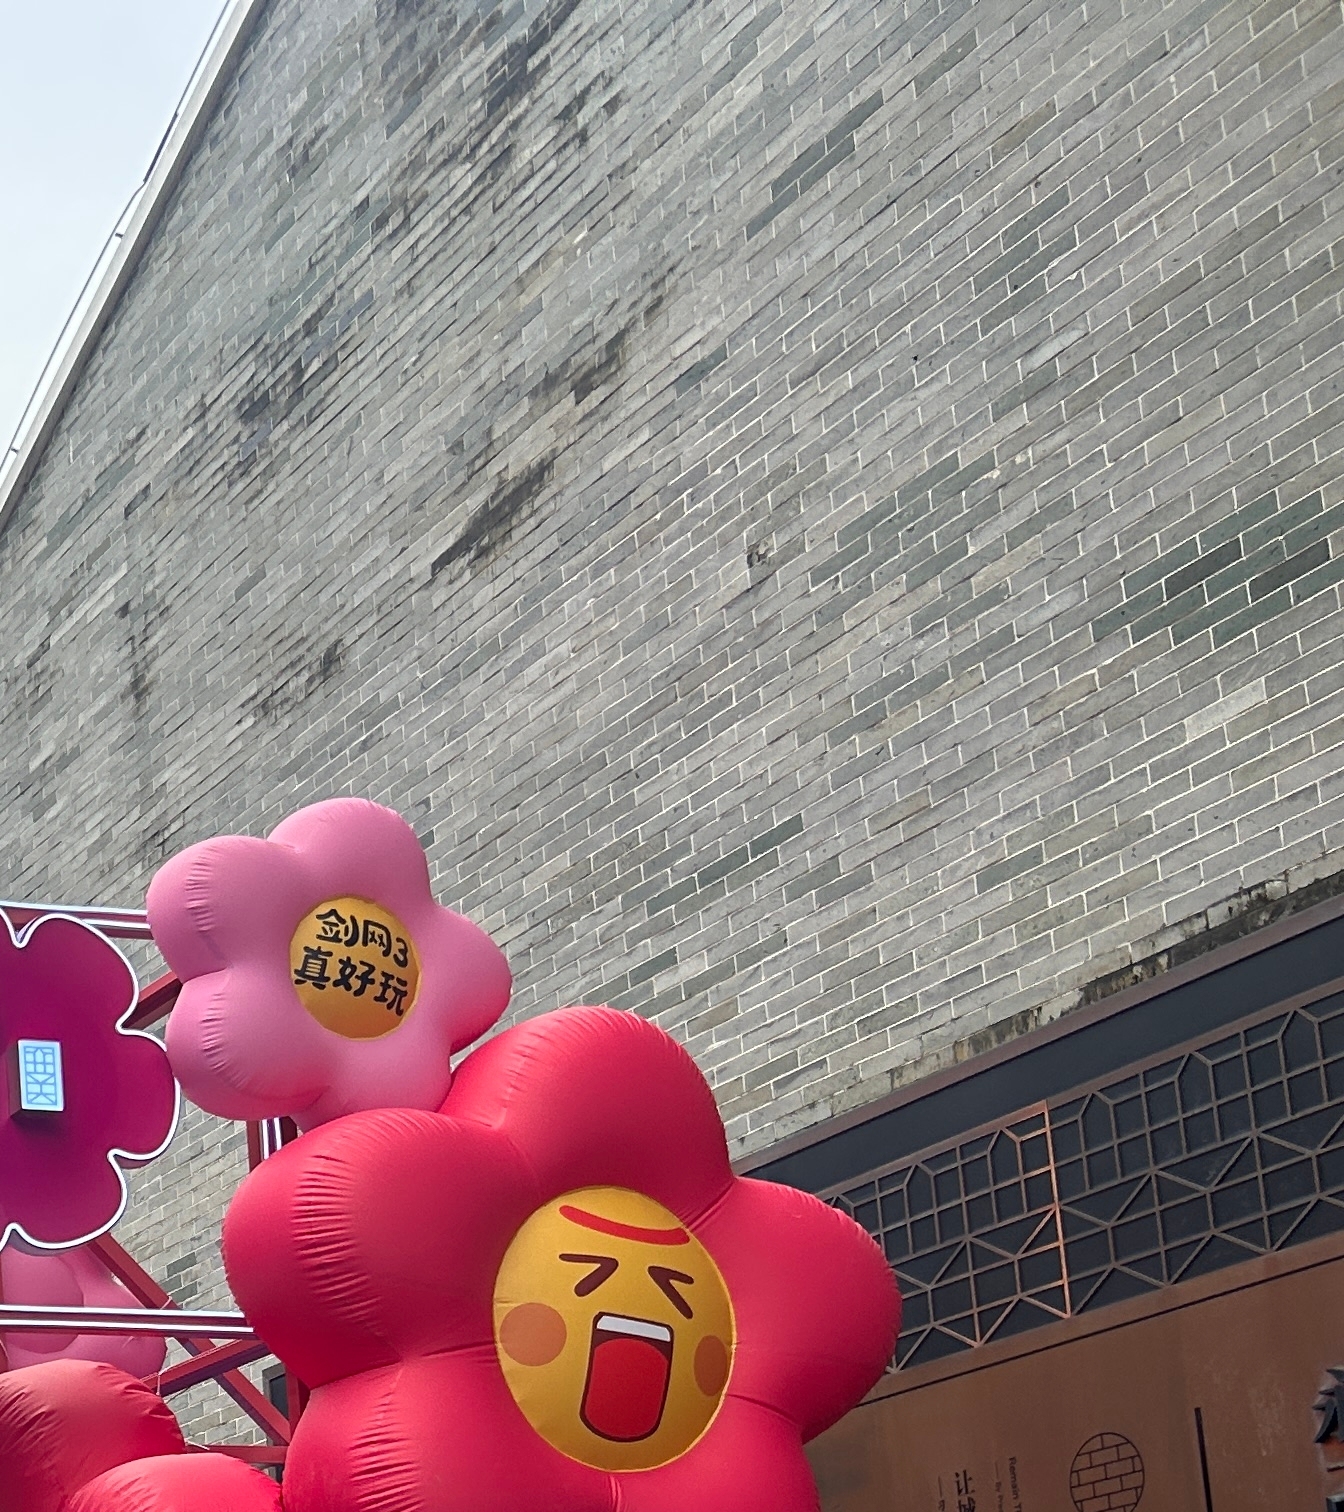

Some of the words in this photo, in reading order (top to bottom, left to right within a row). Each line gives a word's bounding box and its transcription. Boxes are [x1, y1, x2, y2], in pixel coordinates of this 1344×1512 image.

[315, 908, 410, 968] 剑网3
[294, 945, 409, 1017] 真好玩
[1009, 1456, 1019, 1500] Remain
